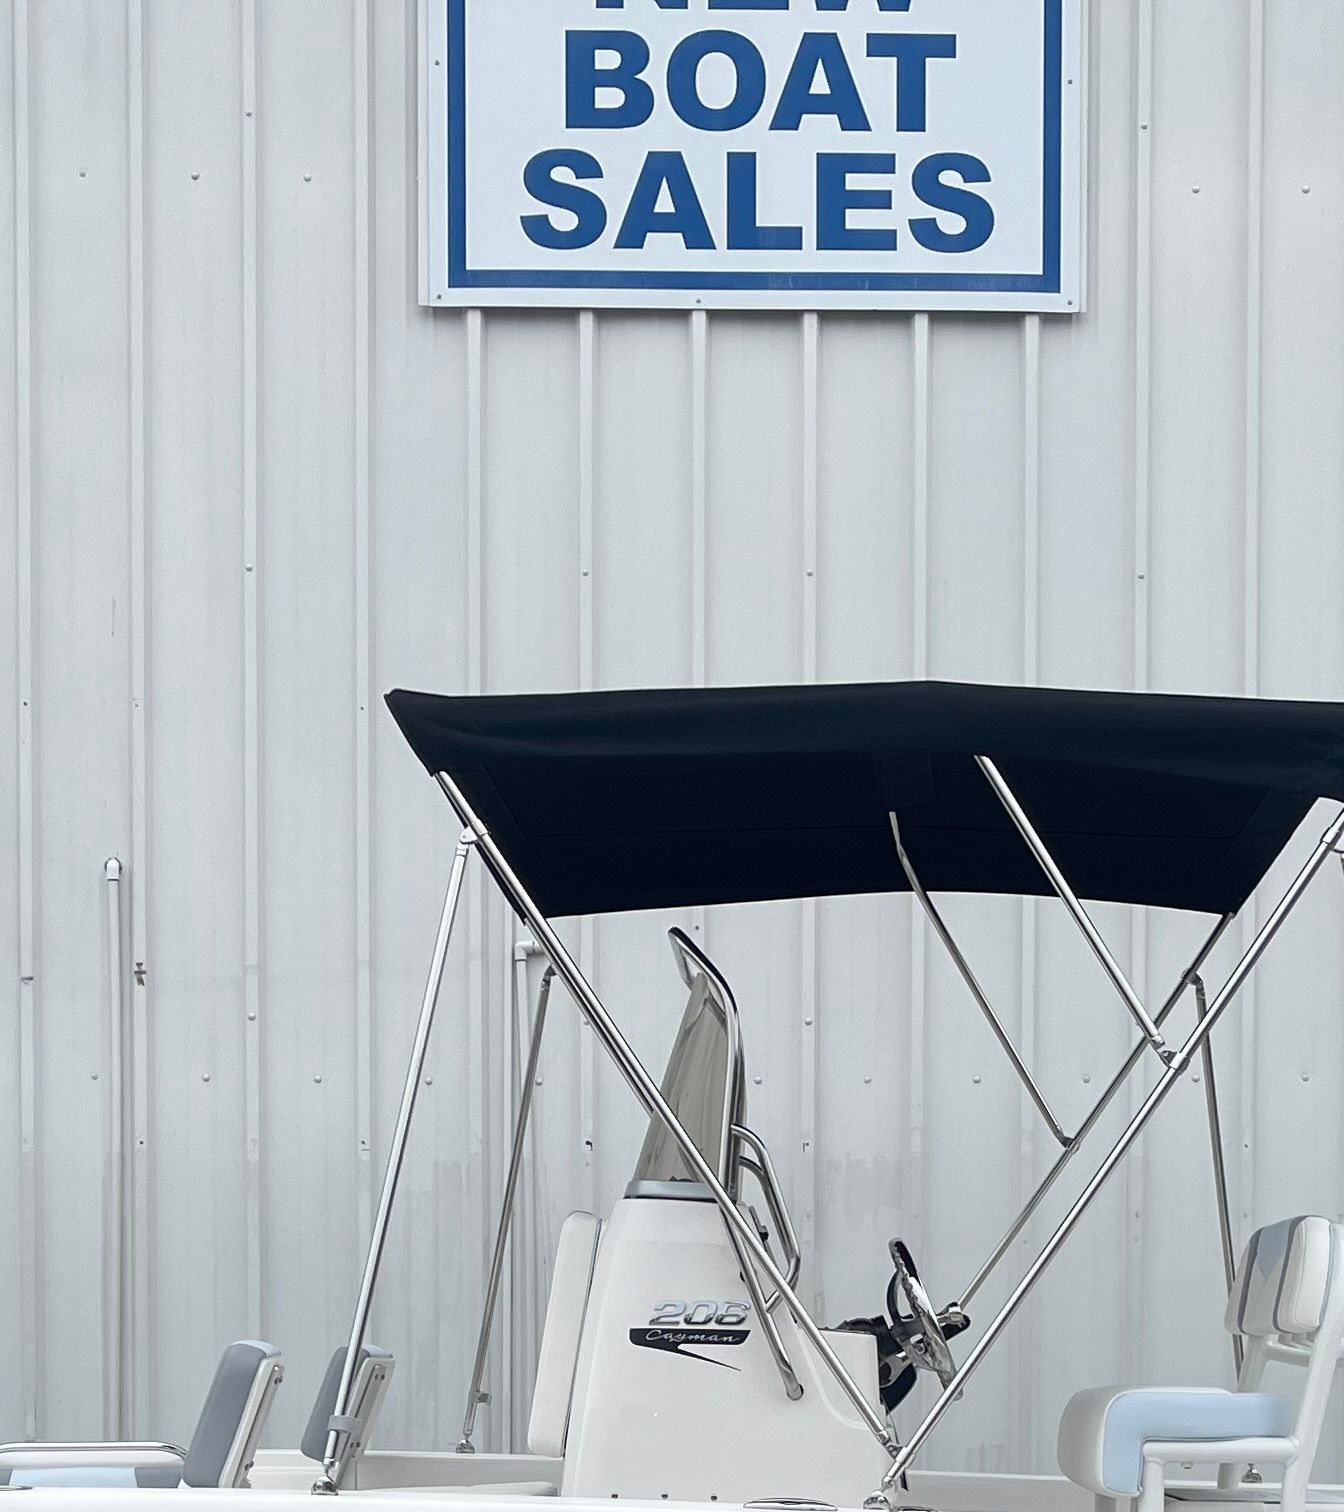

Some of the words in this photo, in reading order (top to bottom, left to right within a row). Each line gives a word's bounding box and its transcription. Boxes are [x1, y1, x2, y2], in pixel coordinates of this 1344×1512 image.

[565, 29, 957, 132] BOAT
[519, 148, 995, 253] SALES
[645, 1329, 740, 1343] Cayman
[648, 1300, 751, 1326] 206
